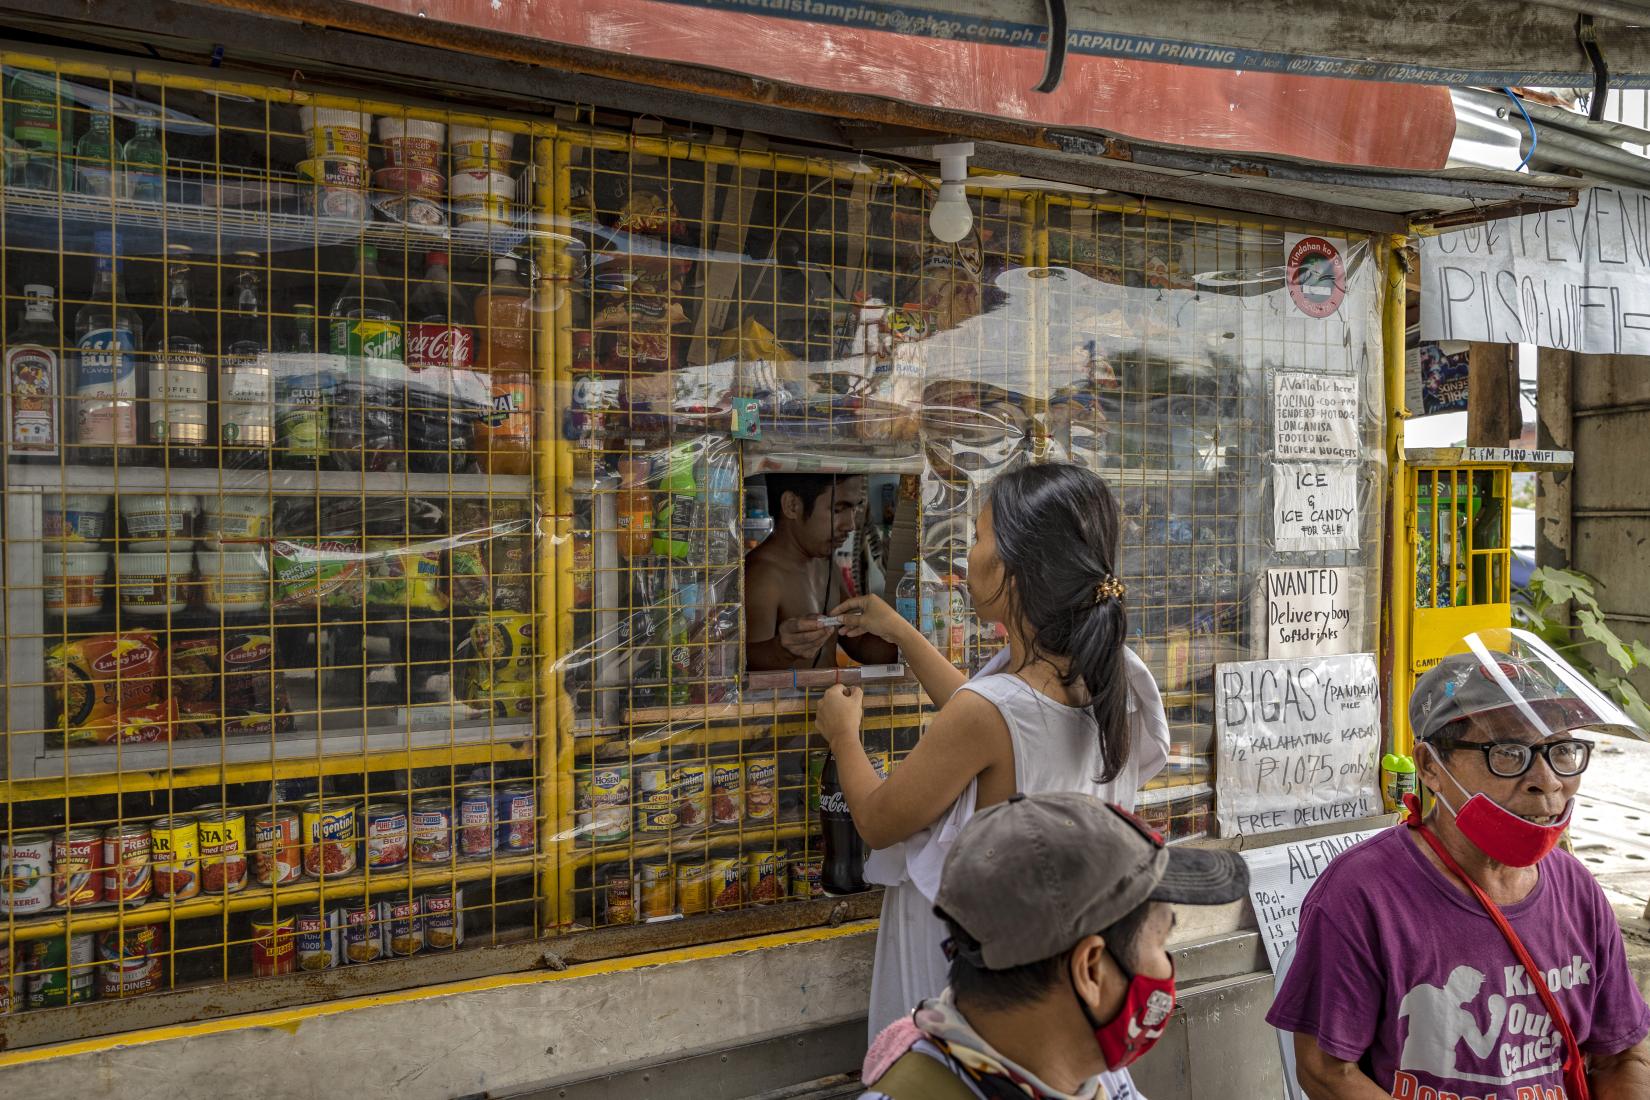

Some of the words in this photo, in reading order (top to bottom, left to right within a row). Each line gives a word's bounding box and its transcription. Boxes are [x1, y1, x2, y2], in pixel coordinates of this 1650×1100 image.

[1066, 35, 1153, 55] ARPAULIN
[1158, 48, 1235, 64] PRINTING
[1292, 242, 1320, 266] Tindahan
[1323, 244, 1331, 254] ko
[363, 334, 401, 359] Sprite
[408, 328, 470, 360] ca-Cola
[81, 356, 122, 367] BLUE
[151, 354, 207, 364] EMERADOR
[1277, 394, 1315, 408] TOCINO
[1319, 446, 1357, 458] NUGGETS
[1296, 472, 1328, 489] ICE
[1281, 510, 1304, 524] ICE
[1310, 508, 1354, 523] CANDY
[1301, 525, 1318, 537] FOR
[1322, 524, 1344, 535] SALE
[1270, 570, 1338, 597] WANTED
[1280, 628, 1338, 643] Softdrinks
[99, 656, 130, 669] Lucy
[1223, 667, 1320, 726] BIGAS
[1250, 731, 1332, 754] KALAHATING
[595, 776, 618, 784] HOSEN
[314, 815, 353, 840] Agentina
[1237, 810, 1286, 833] FREE
[200, 829, 232, 843] STAR
[121, 838, 151, 852] FRESC
[122, 847, 151, 860] SARDIN
[1287, 833, 1364, 884] ALFON
[2, 897, 40, 907] MAKEREL
[429, 899, 450, 910] 555
[1272, 905, 1298, 921] Liter
[352, 930, 377, 940] MECHDO
[1508, 1003, 1553, 1037] Out
[1499, 1031, 1564, 1077] Cance
